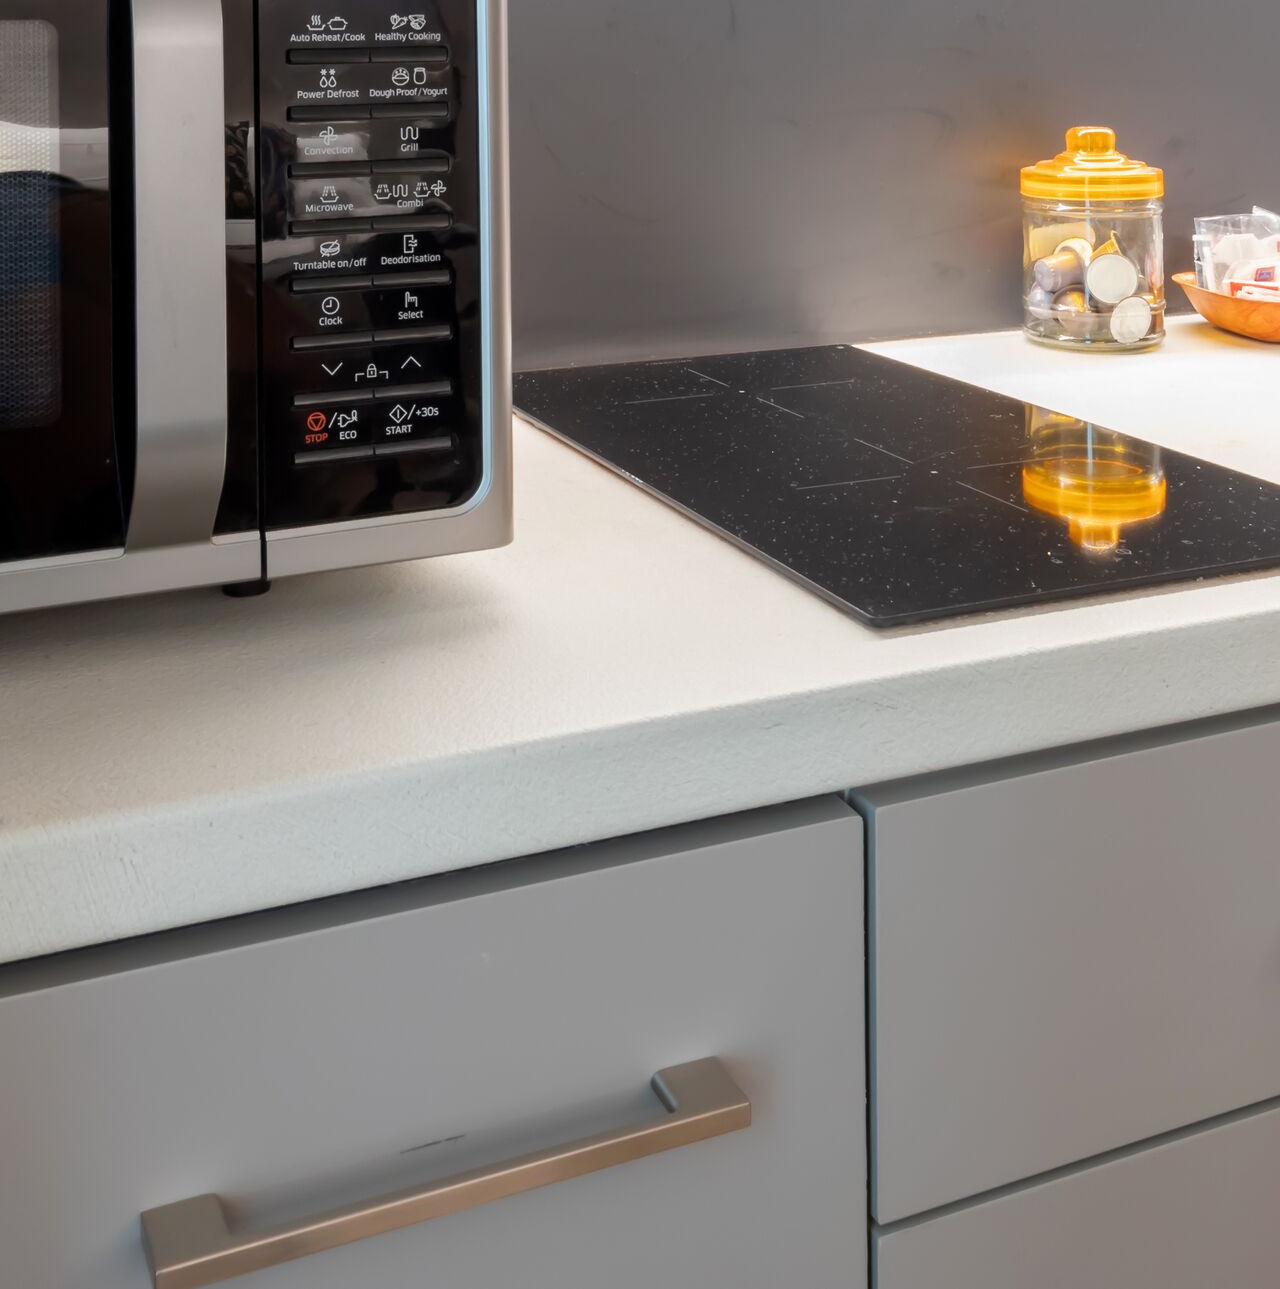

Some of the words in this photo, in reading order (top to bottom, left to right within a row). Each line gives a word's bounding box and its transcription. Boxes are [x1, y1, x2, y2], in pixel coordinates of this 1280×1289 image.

[290, 33, 310, 43] Auto
[374, 32, 407, 43] Healthy
[408, 31, 441, 42] Cooking
[297, 90, 325, 100] Power
[326, 89, 359, 99] Defrost
[369, 88, 395, 99] Dough
[304, 145, 354, 156] Convection
[400, 143, 419, 152] Grill
[305, 203, 354, 213] Microwave
[396, 198, 424, 208] Combi
[293, 259, 336, 271] Turntable
[337, 257, 367, 268] on/off
[380, 253, 441, 265] Deodorisation
[319, 315, 343, 326] Clock
[398, 310, 424, 320] Select
[339, 430, 357, 440] ECO
[385, 424, 412, 435] START
[305, 433, 328, 444] STOP
